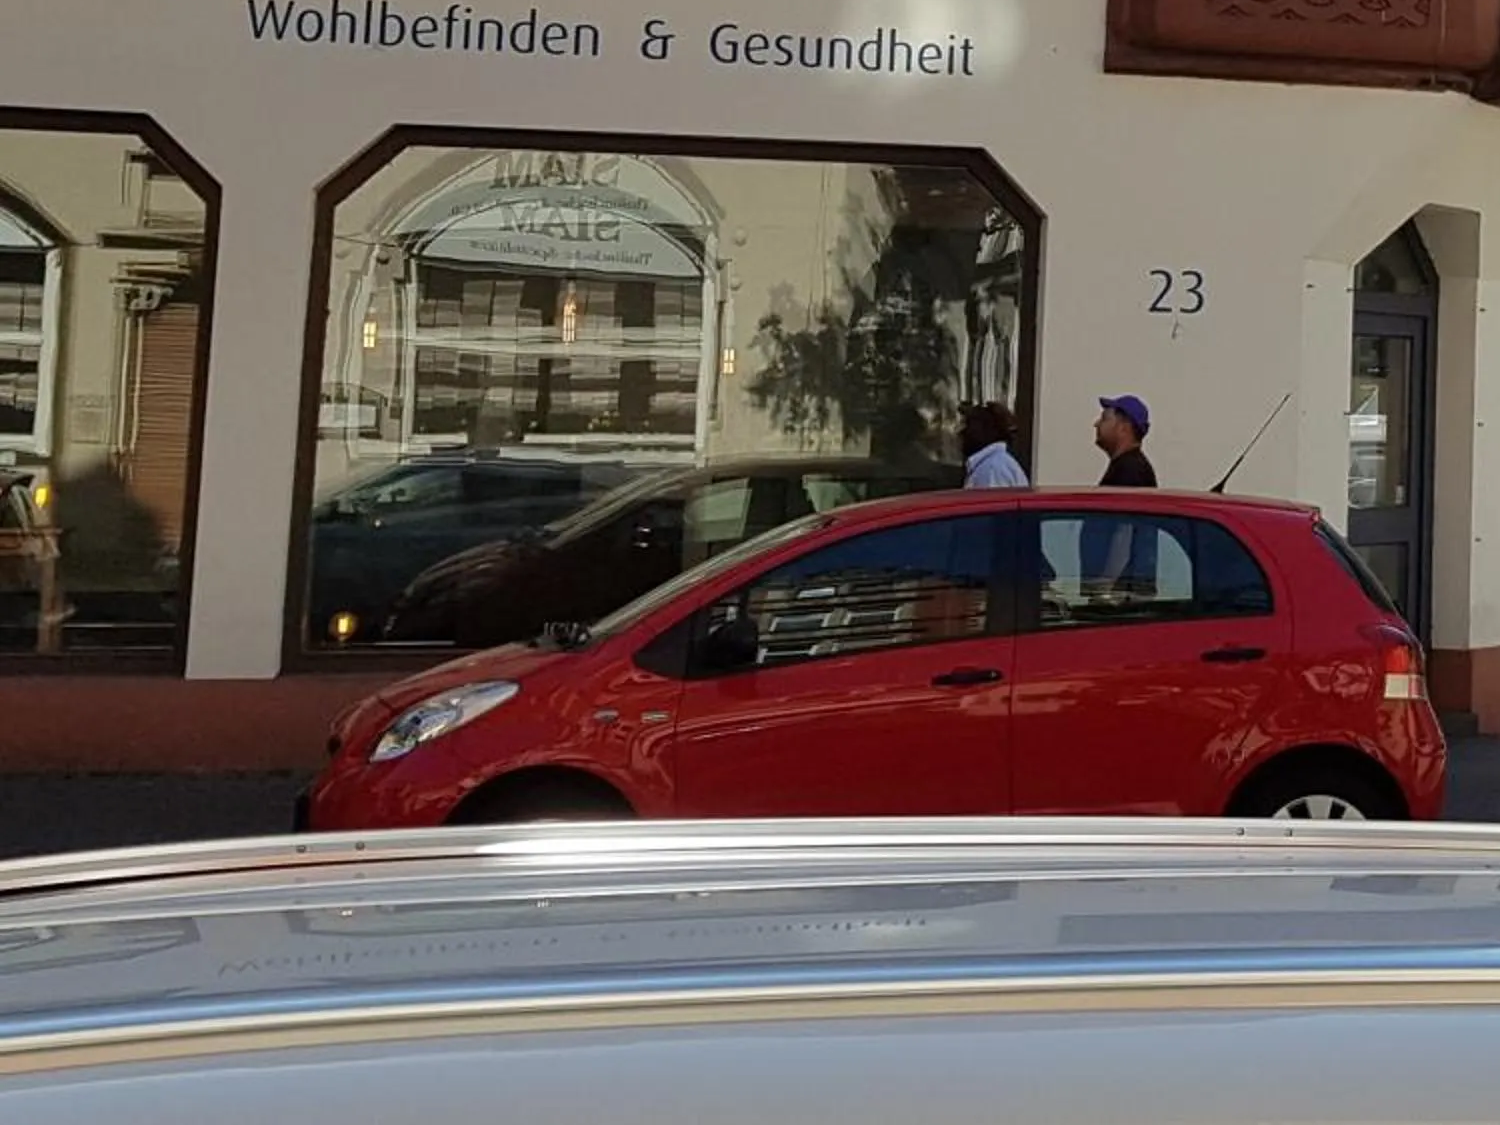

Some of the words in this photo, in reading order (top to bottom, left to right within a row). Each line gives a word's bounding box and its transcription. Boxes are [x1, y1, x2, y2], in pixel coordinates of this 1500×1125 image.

[640, 19, 676, 60] &
[709, 23, 976, 77] Gesundheit
[1147, 269, 1205, 314] 23
